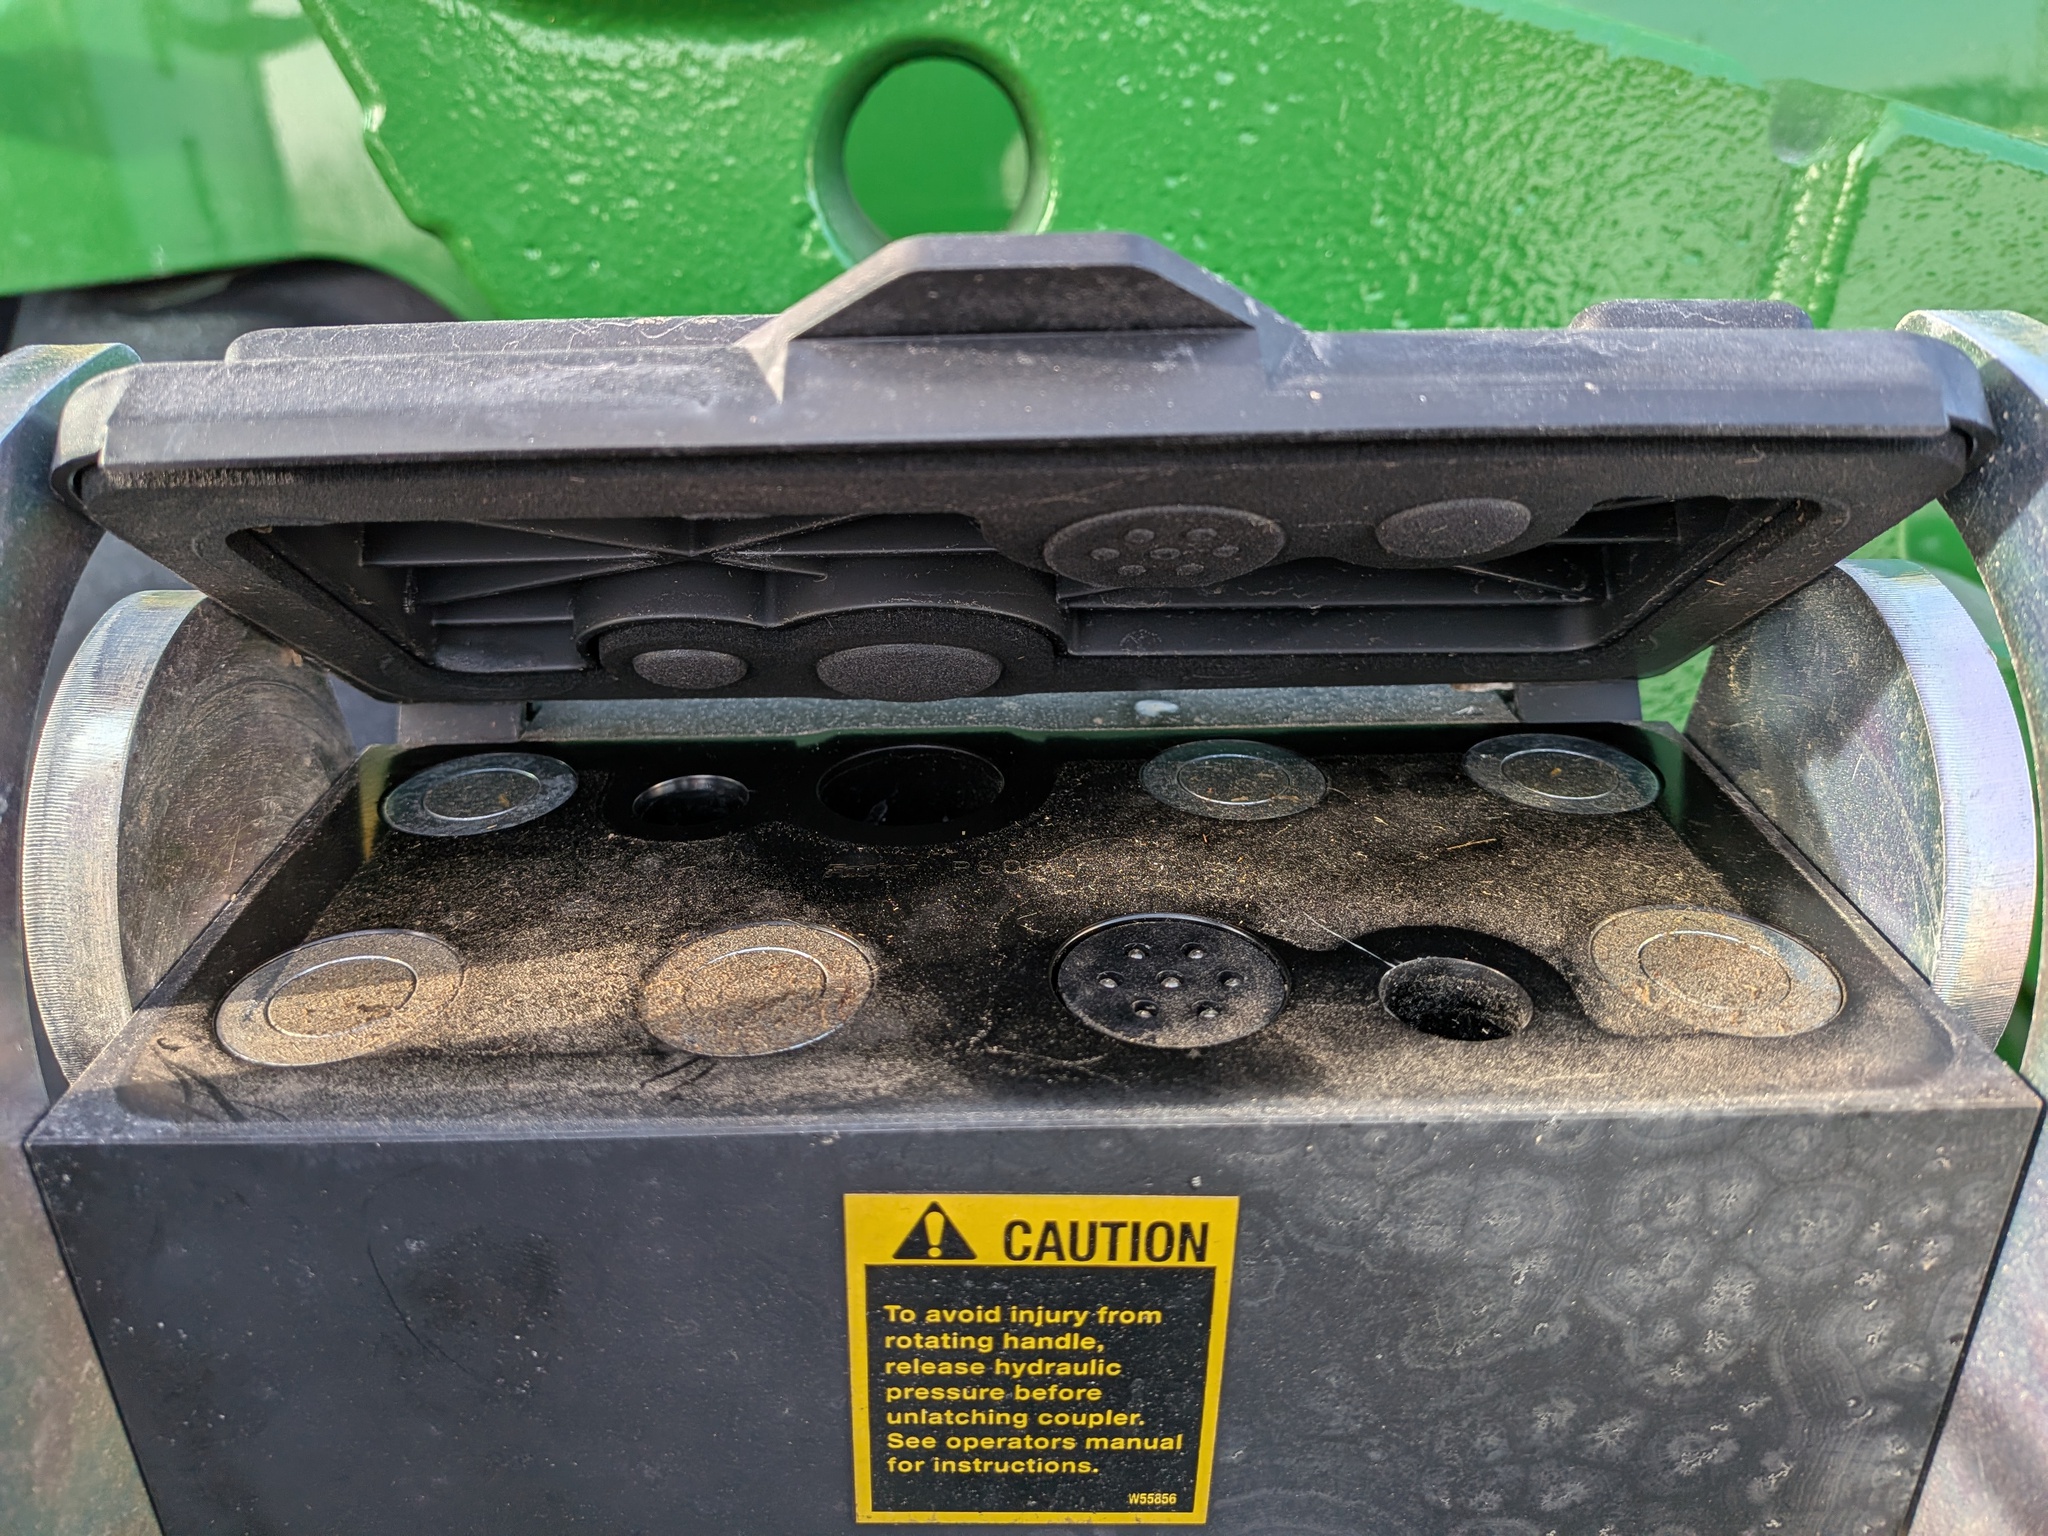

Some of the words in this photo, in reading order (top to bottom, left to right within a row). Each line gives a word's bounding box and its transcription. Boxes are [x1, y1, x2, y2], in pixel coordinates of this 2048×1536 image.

[1004, 1219, 1210, 1263] CAUTION
[883, 1305, 916, 1324] To
[925, 1305, 1001, 1324] avoid
[1010, 1306, 1089, 1328] injury
[1098, 1306, 1163, 1324] from
[884, 1333, 994, 1353] rotating
[1002, 1333, 1105, 1353] handle,
[884, 1359, 986, 1376] release
[994, 1359, 1122, 1377] hydraulic
[885, 1385, 1005, 1404] pressure
[1014, 1384, 1103, 1401] before
[886, 1409, 1028, 1429] unlatching
[1037, 1409, 1146, 1429] coupler.
[886, 1433, 939, 1449] See
[946, 1435, 1076, 1452] operators
[1085, 1434, 1183, 1450] manual
[887, 1457, 925, 1474] for
[933, 1457, 1100, 1475] instructions.
[1128, 1492, 1178, 1506] W55856
